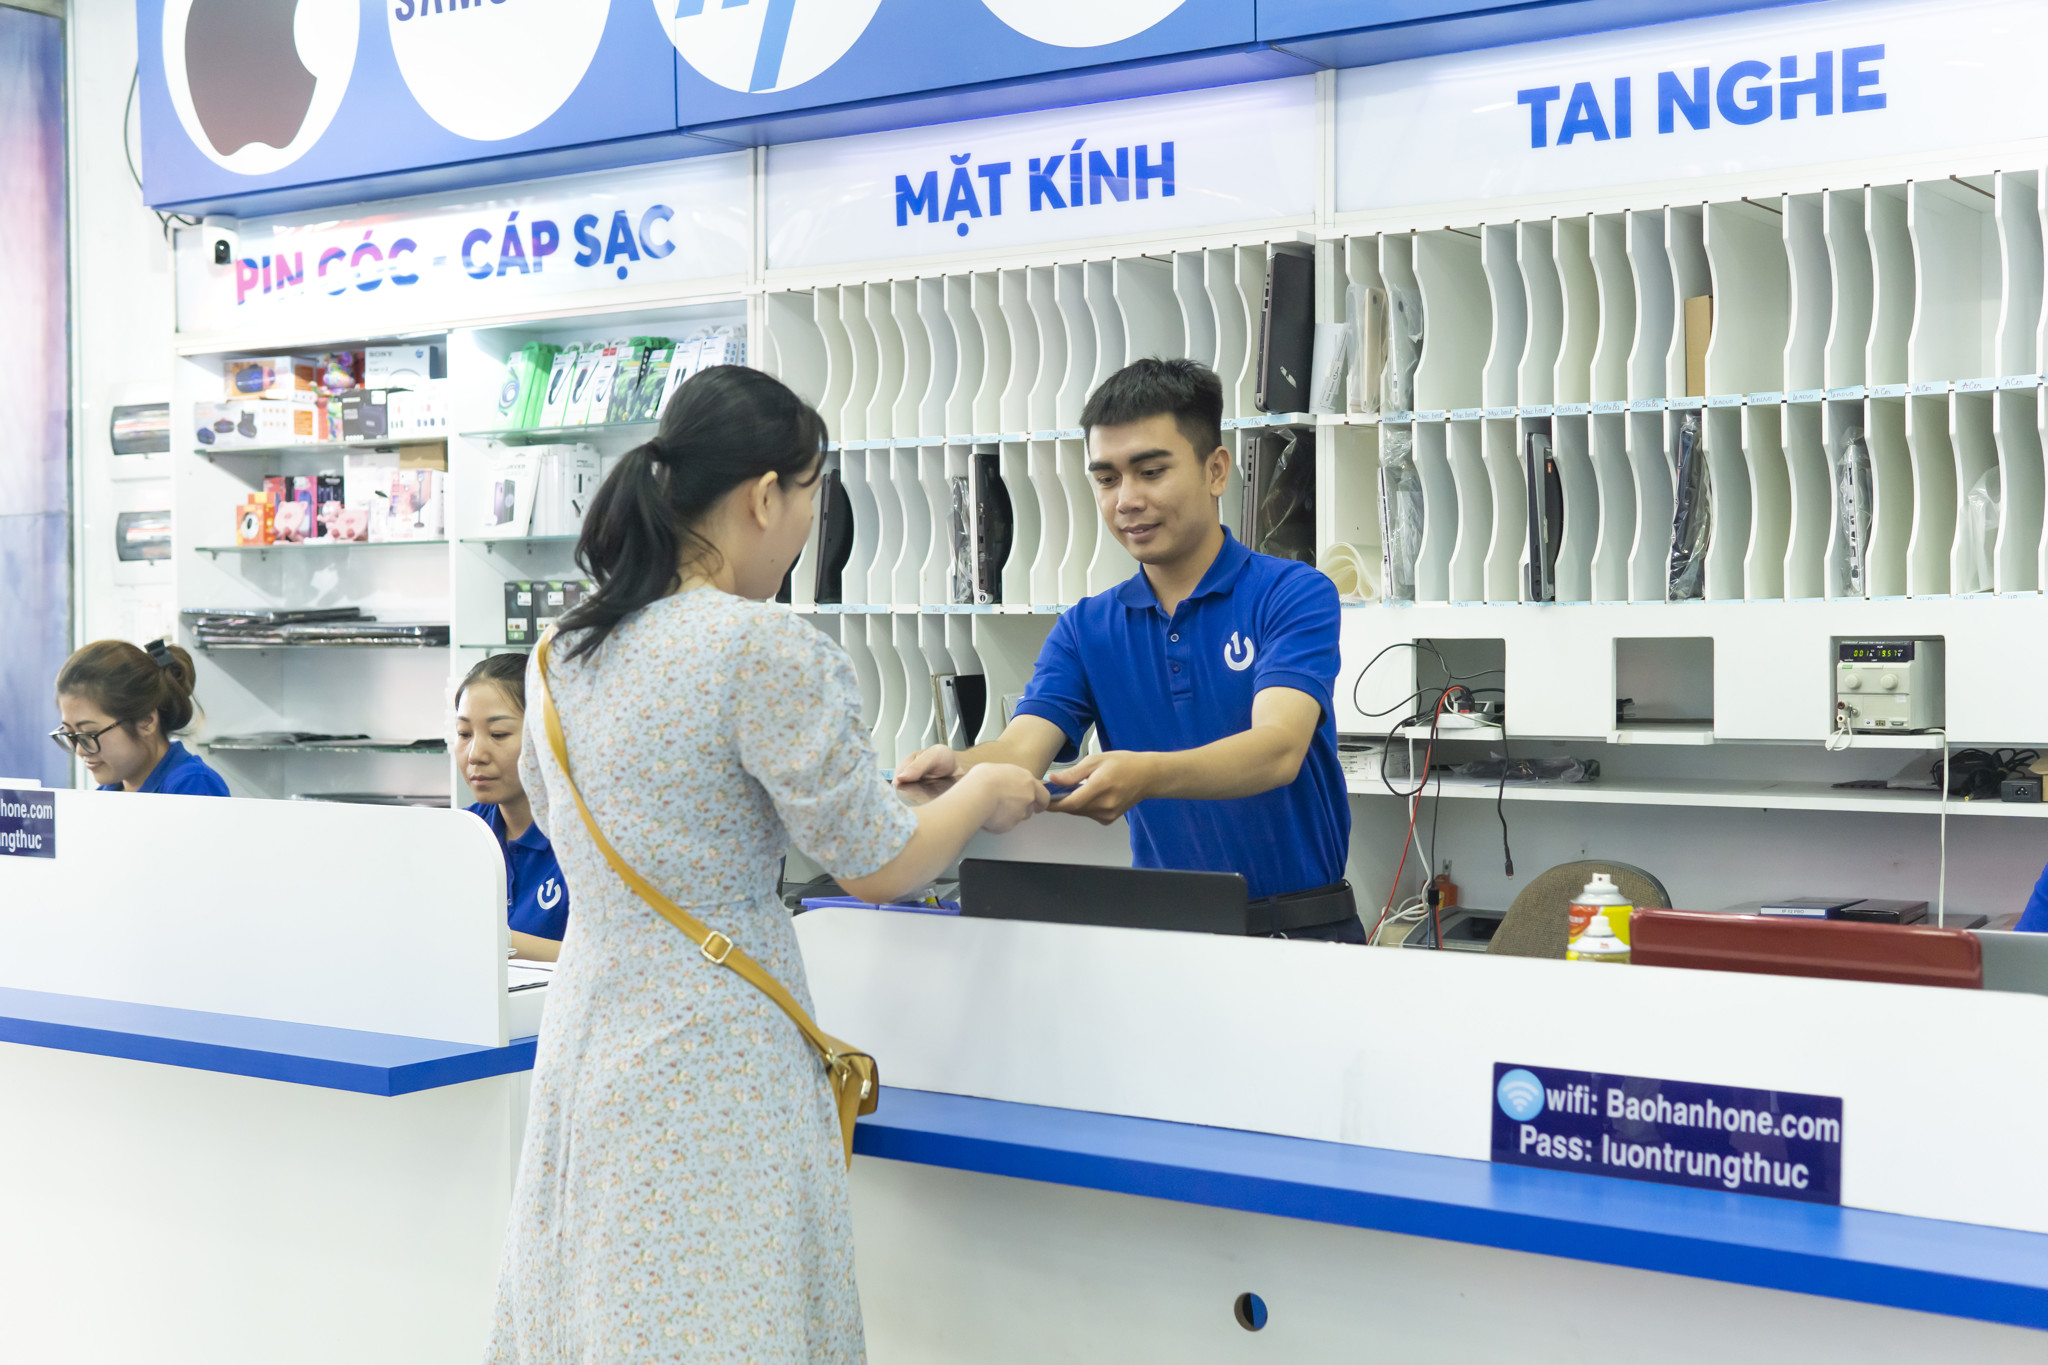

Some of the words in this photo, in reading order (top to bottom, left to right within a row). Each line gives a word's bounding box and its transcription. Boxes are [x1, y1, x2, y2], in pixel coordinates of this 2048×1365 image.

[1517, 75, 1632, 149] TAI
[1658, 43, 1888, 134] NGHE
[895, 152, 1013, 237] MẶT
[1029, 138, 1175, 212] KÍNH
[236, 249, 304, 305] PIN
[461, 211, 560, 280] CÁP
[573, 204, 677, 281] SẠC
[0, 798, 53, 819] hone.com
[0, 829, 42, 853] ngthuc
[1546, 1083, 1598, 1116] wifi:
[1606, 1088, 1840, 1143] Baohanhone.com
[1519, 1124, 1592, 1162] Pass:
[1602, 1134, 1809, 1189] luontrungthuc
